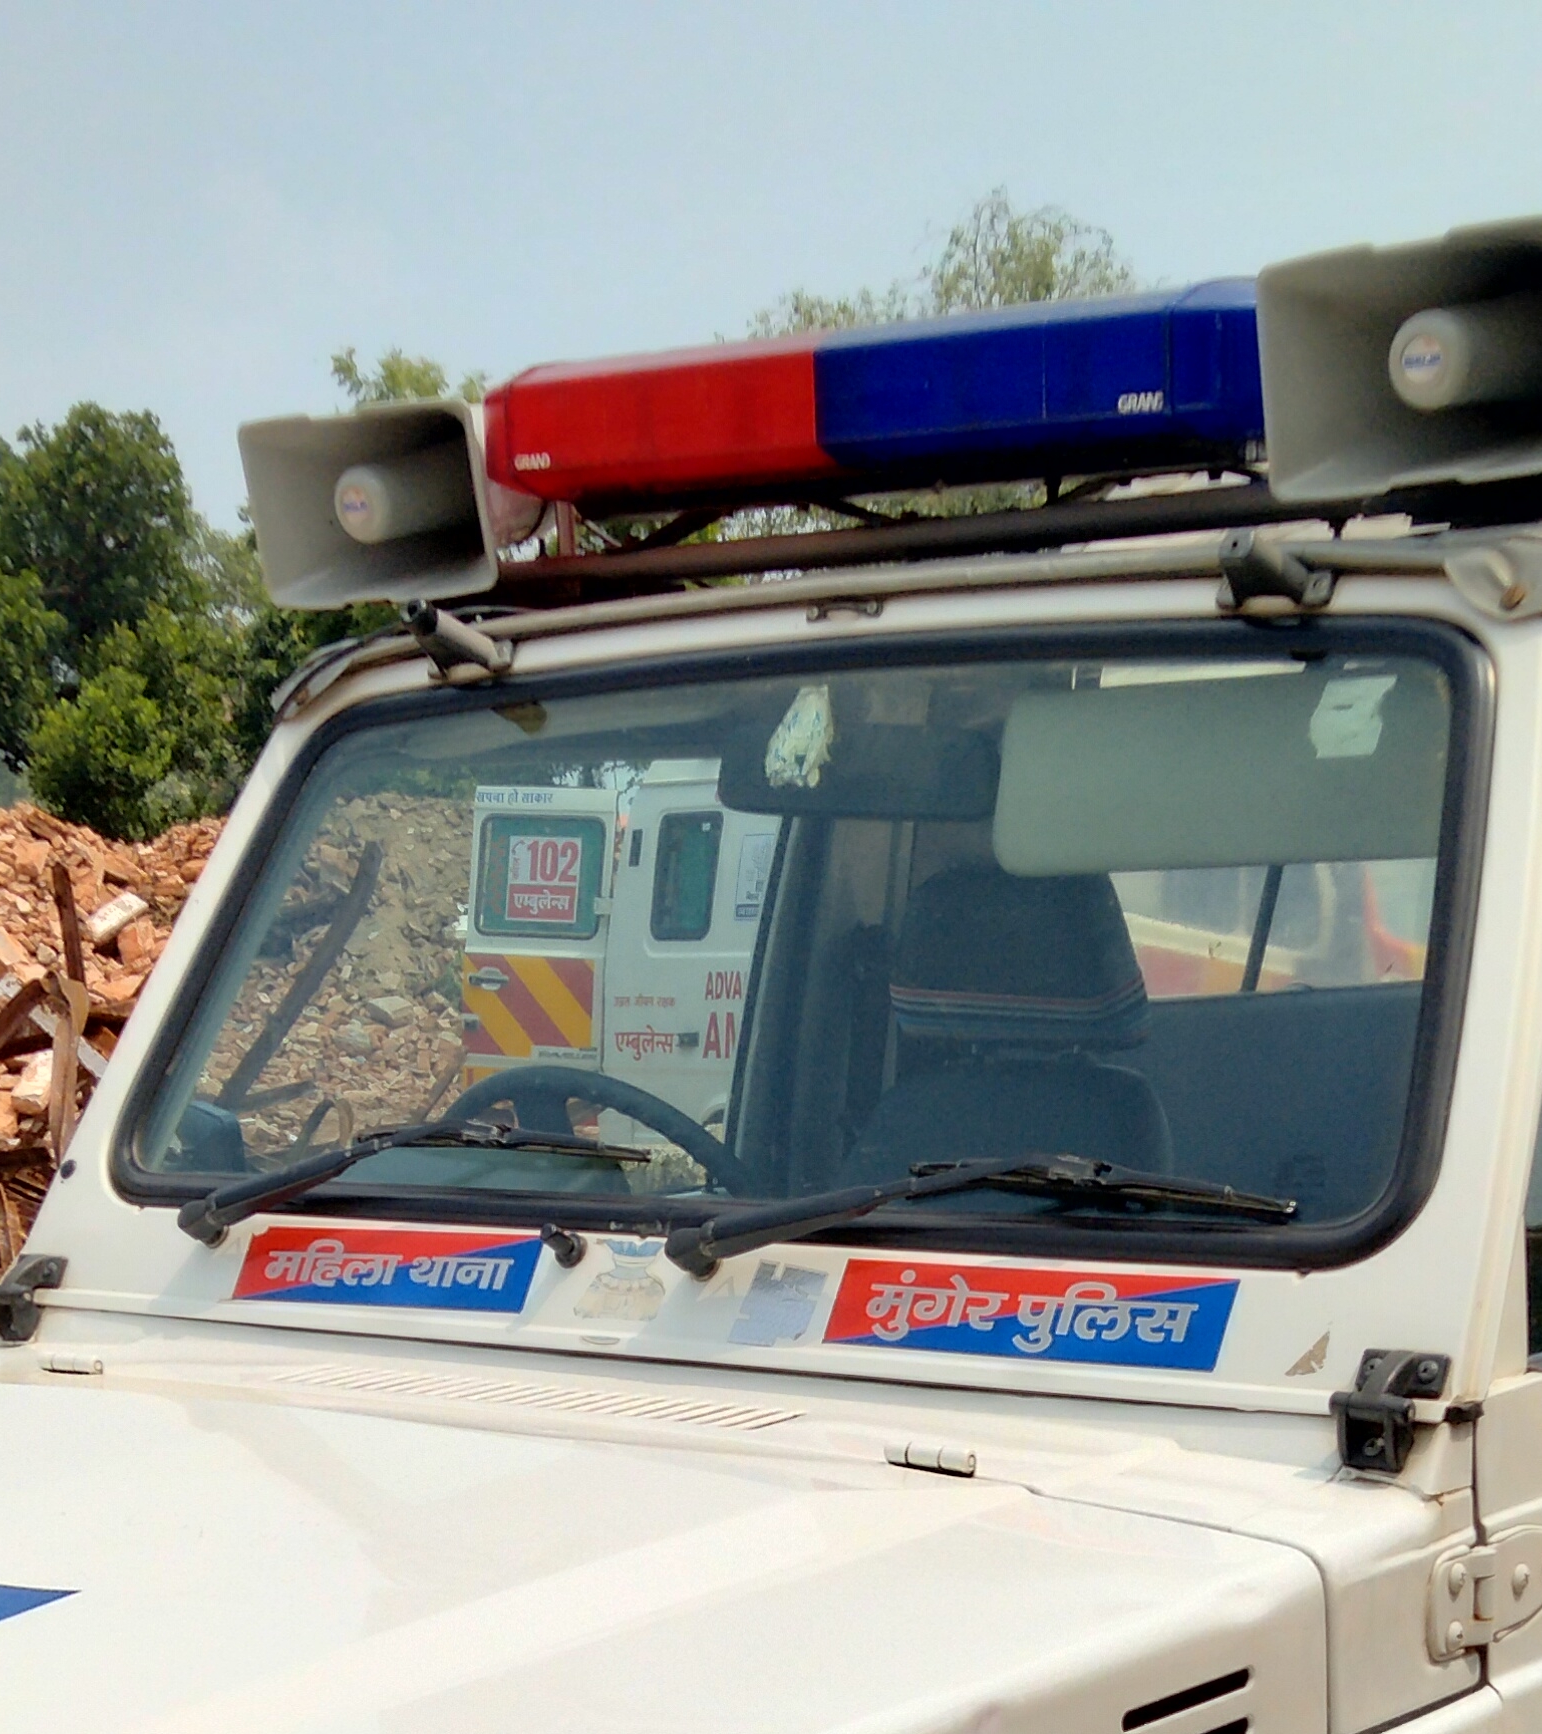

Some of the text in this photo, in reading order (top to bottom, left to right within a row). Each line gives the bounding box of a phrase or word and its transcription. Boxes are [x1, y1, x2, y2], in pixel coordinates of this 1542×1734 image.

[528, 840, 579, 882] 102
[513, 890, 570, 915] एम्बुलेन्स
[705, 971, 748, 1000] ADVA
[614, 1025, 674, 1061] एम्बुलेन्स
[264, 1239, 514, 1291] महिला थाना
[866, 1269, 1199, 1353] मुंगेर पुलिस
